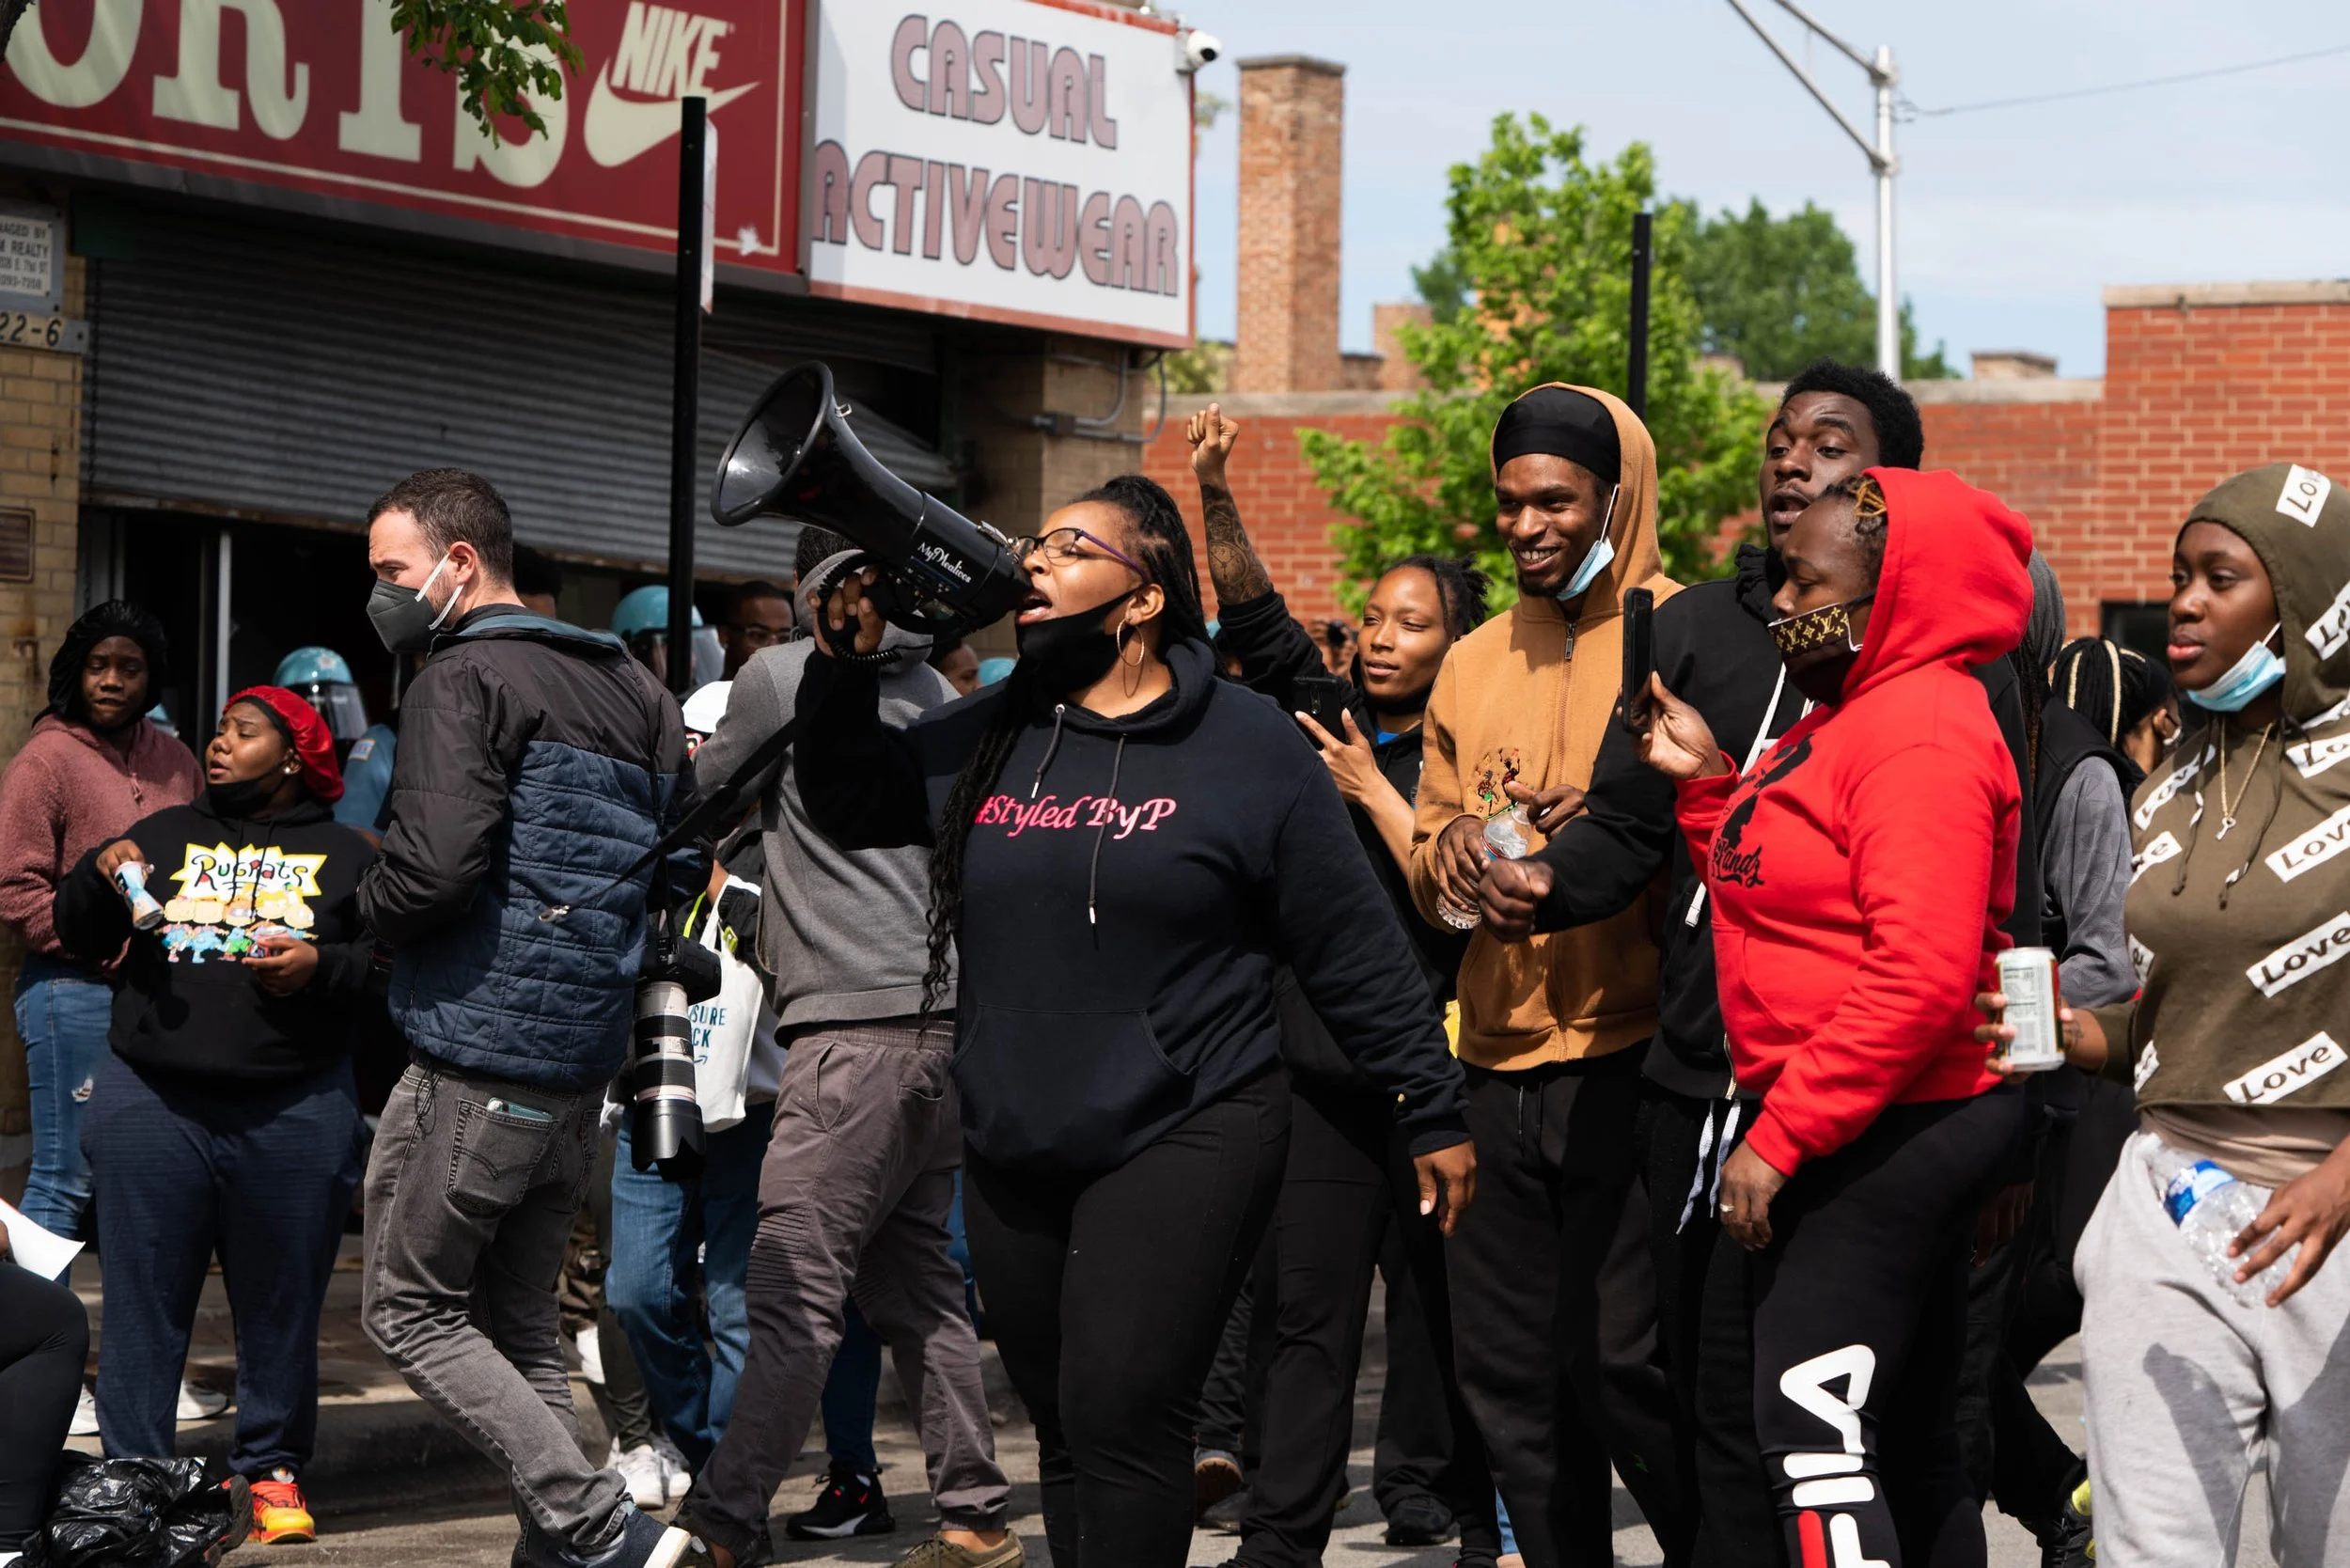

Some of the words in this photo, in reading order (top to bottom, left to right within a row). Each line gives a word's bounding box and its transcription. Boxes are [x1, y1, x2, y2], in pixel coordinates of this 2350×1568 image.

[610, 1, 729, 99] NIKE
[890, 13, 1118, 151] CASUAL
[810, 138, 1180, 299] ACTIVEWEAR
[2261, 927, 2350, 984] Love
[2240, 1046, 2332, 1103] Love
